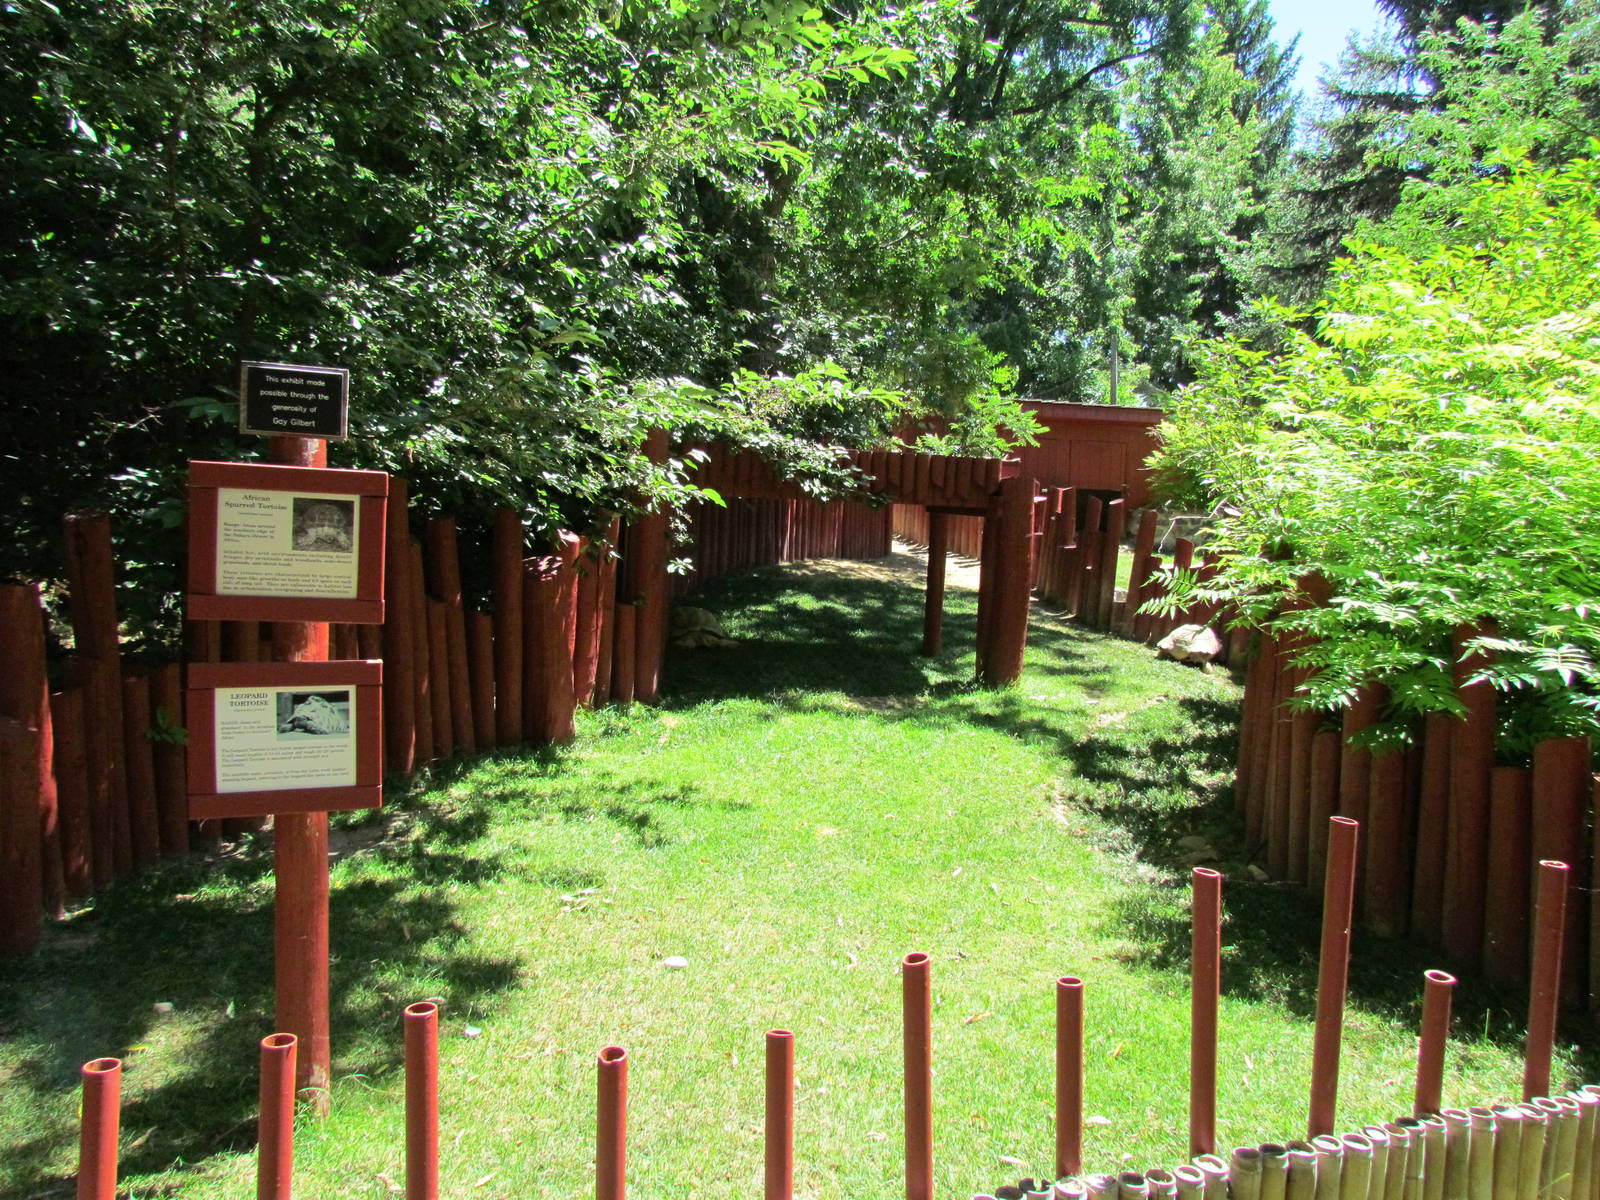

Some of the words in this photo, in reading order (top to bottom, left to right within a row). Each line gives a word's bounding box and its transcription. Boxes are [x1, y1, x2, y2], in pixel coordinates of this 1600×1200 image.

[265, 375, 279, 383] This
[281, 377, 304, 385] exhibit
[306, 379, 326, 387] made
[260, 390, 288, 398] possible
[290, 391, 316, 400] through
[318, 393, 330, 401] the
[271, 404, 307, 413] generosity
[290, 418, 316, 427] Gilbert
[242, 494, 271, 502] African
[230, 692, 268, 700] LEOPARD
[229, 699, 269, 707] TORTOISE
